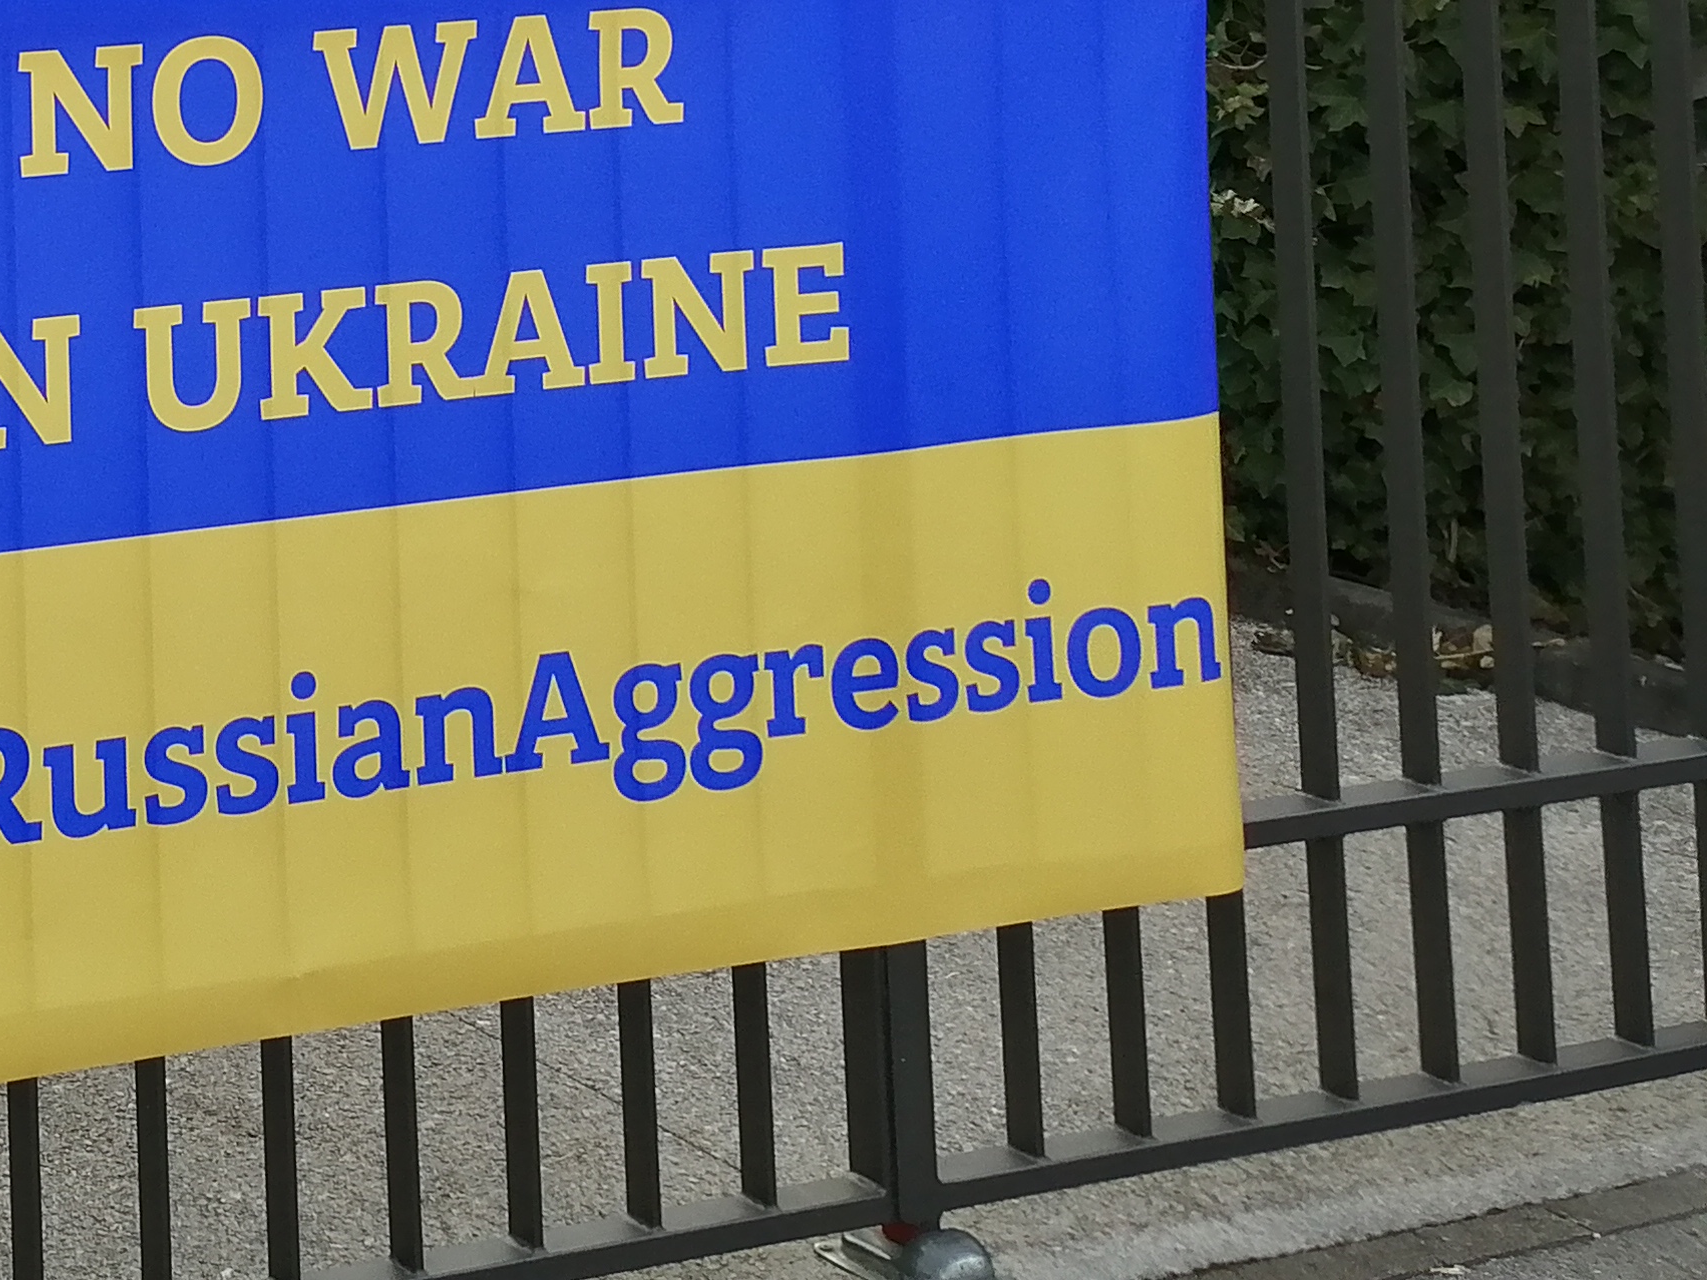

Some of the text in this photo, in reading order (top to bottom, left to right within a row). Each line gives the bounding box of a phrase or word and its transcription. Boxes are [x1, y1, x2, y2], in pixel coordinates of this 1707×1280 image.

[19, 7, 684, 179] NO WAR
[134, 242, 851, 434] UKRAINE
